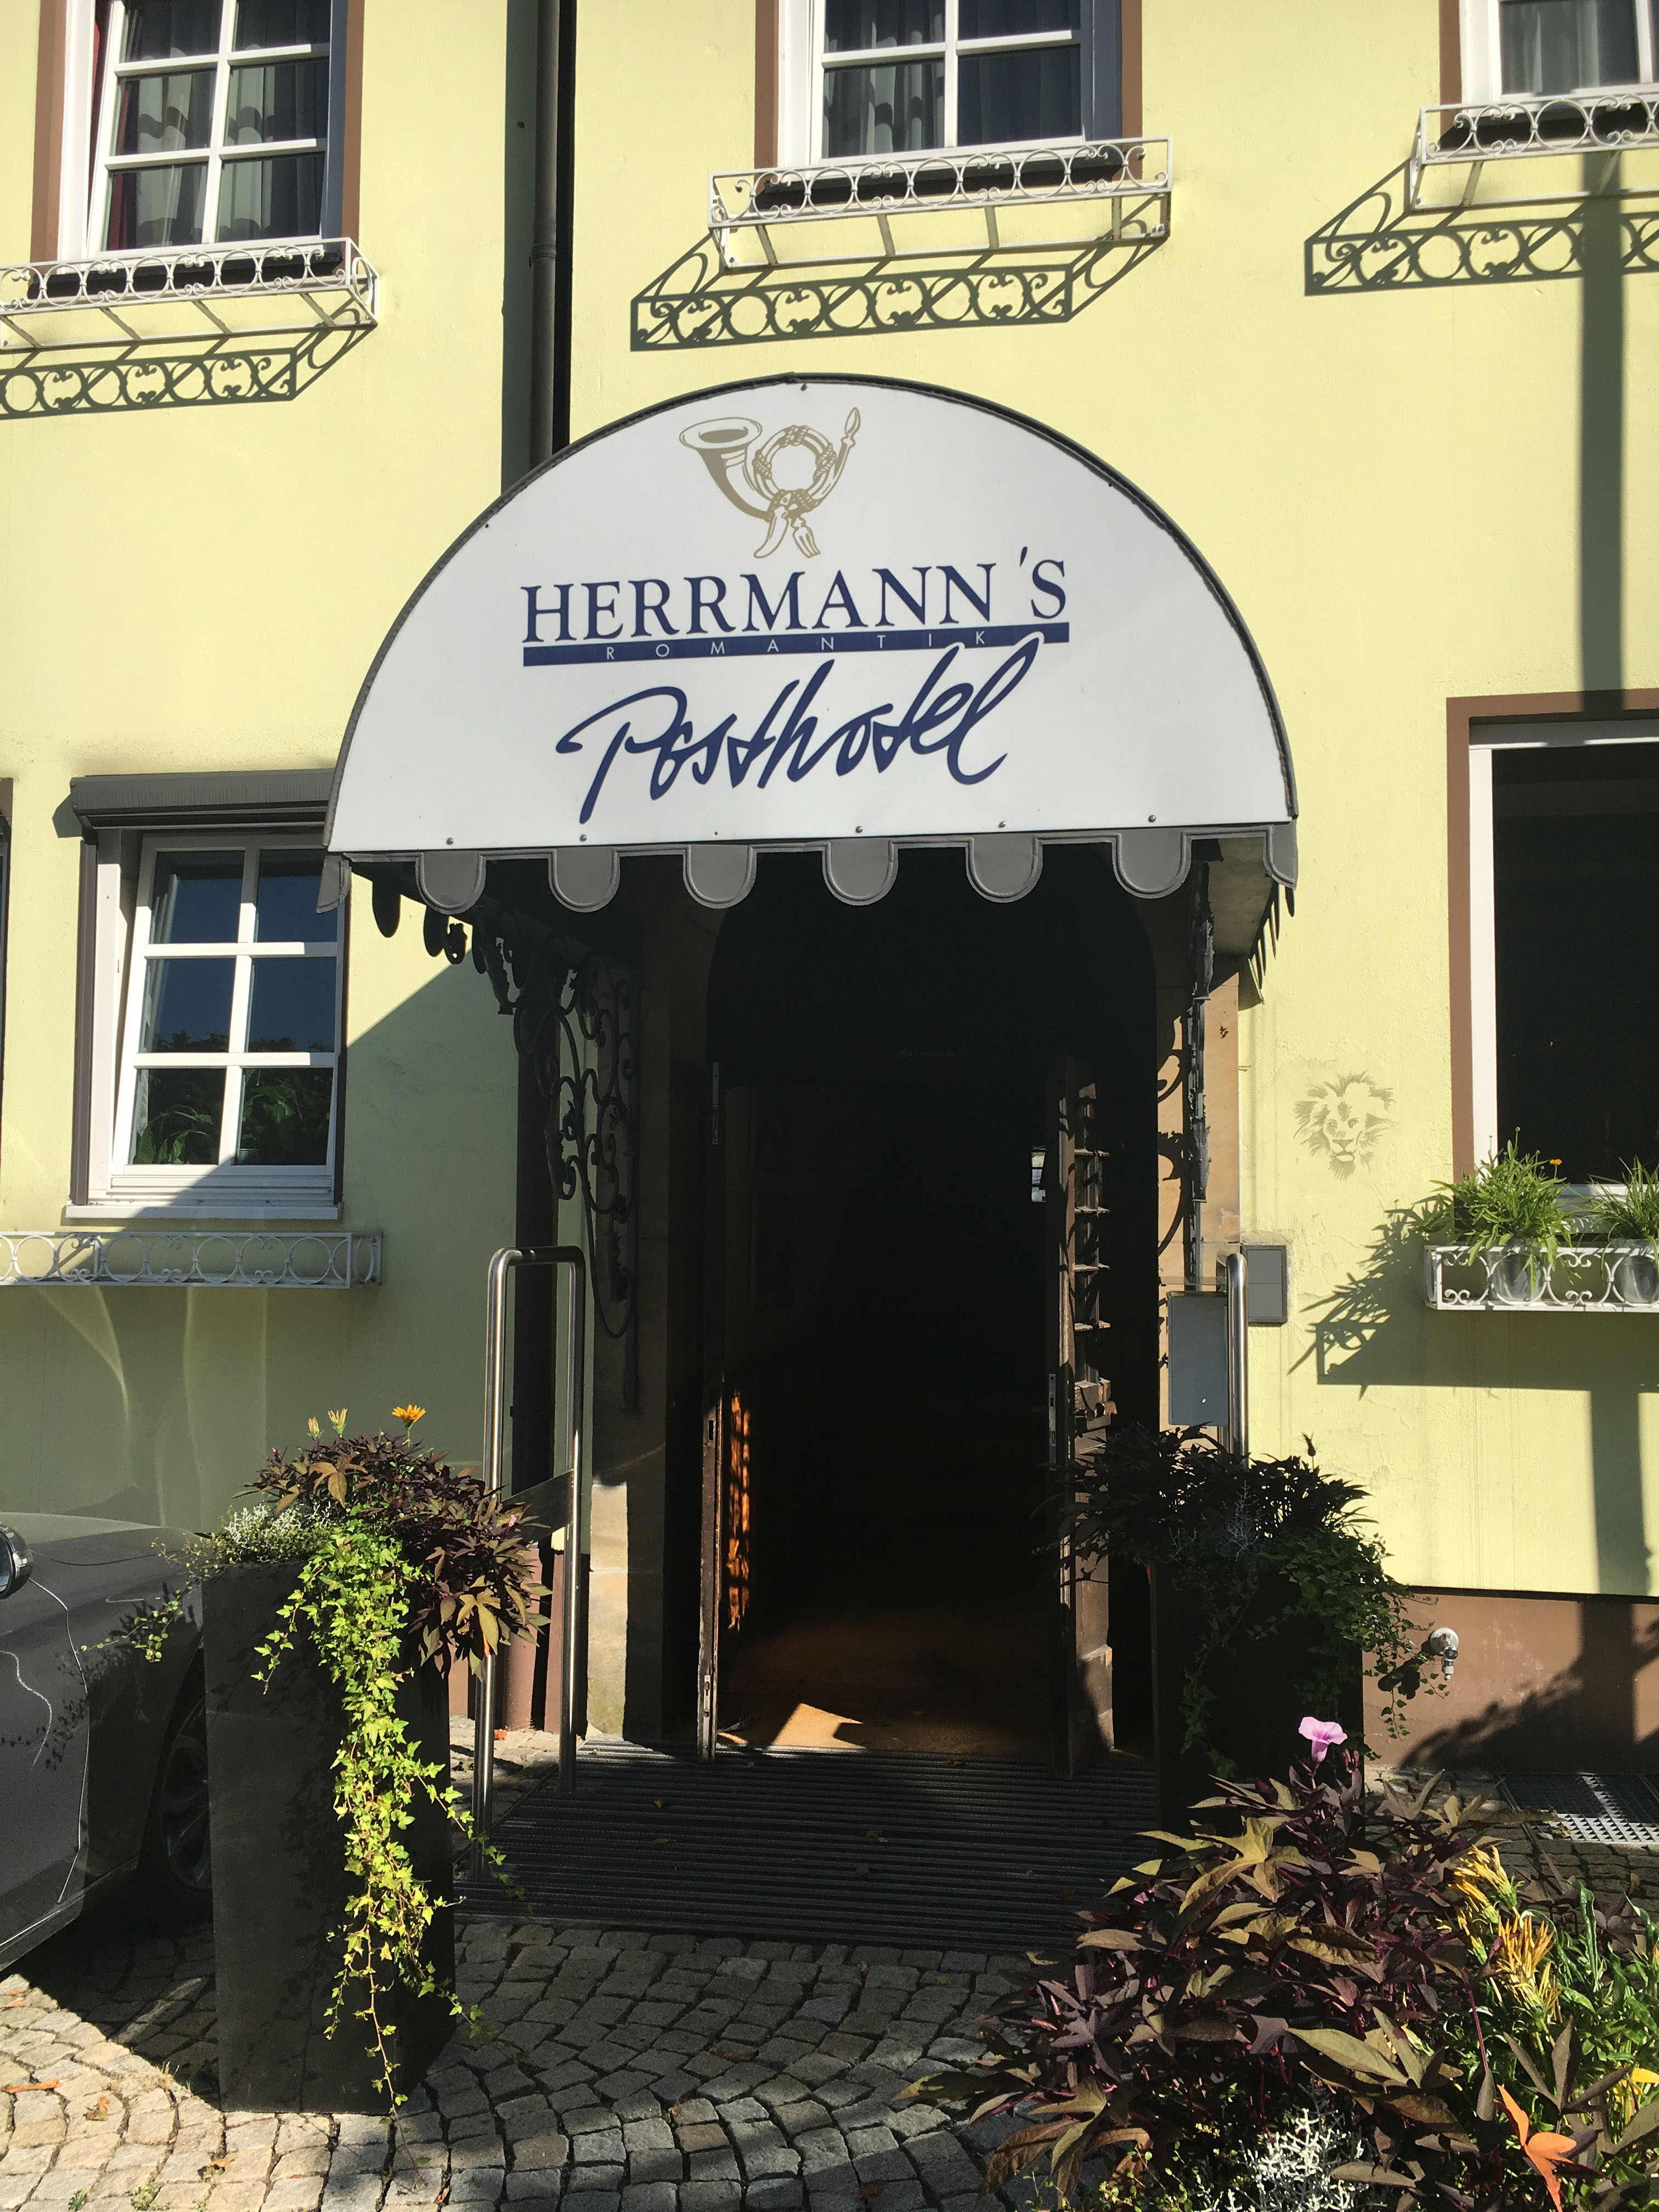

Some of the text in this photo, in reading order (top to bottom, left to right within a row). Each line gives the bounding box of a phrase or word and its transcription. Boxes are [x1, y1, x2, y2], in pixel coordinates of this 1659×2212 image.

[521, 547, 1066, 642] HERRMANN'S
[606, 631, 986, 660] ROMANTIK
[555, 634, 1044, 823] Posthotel
